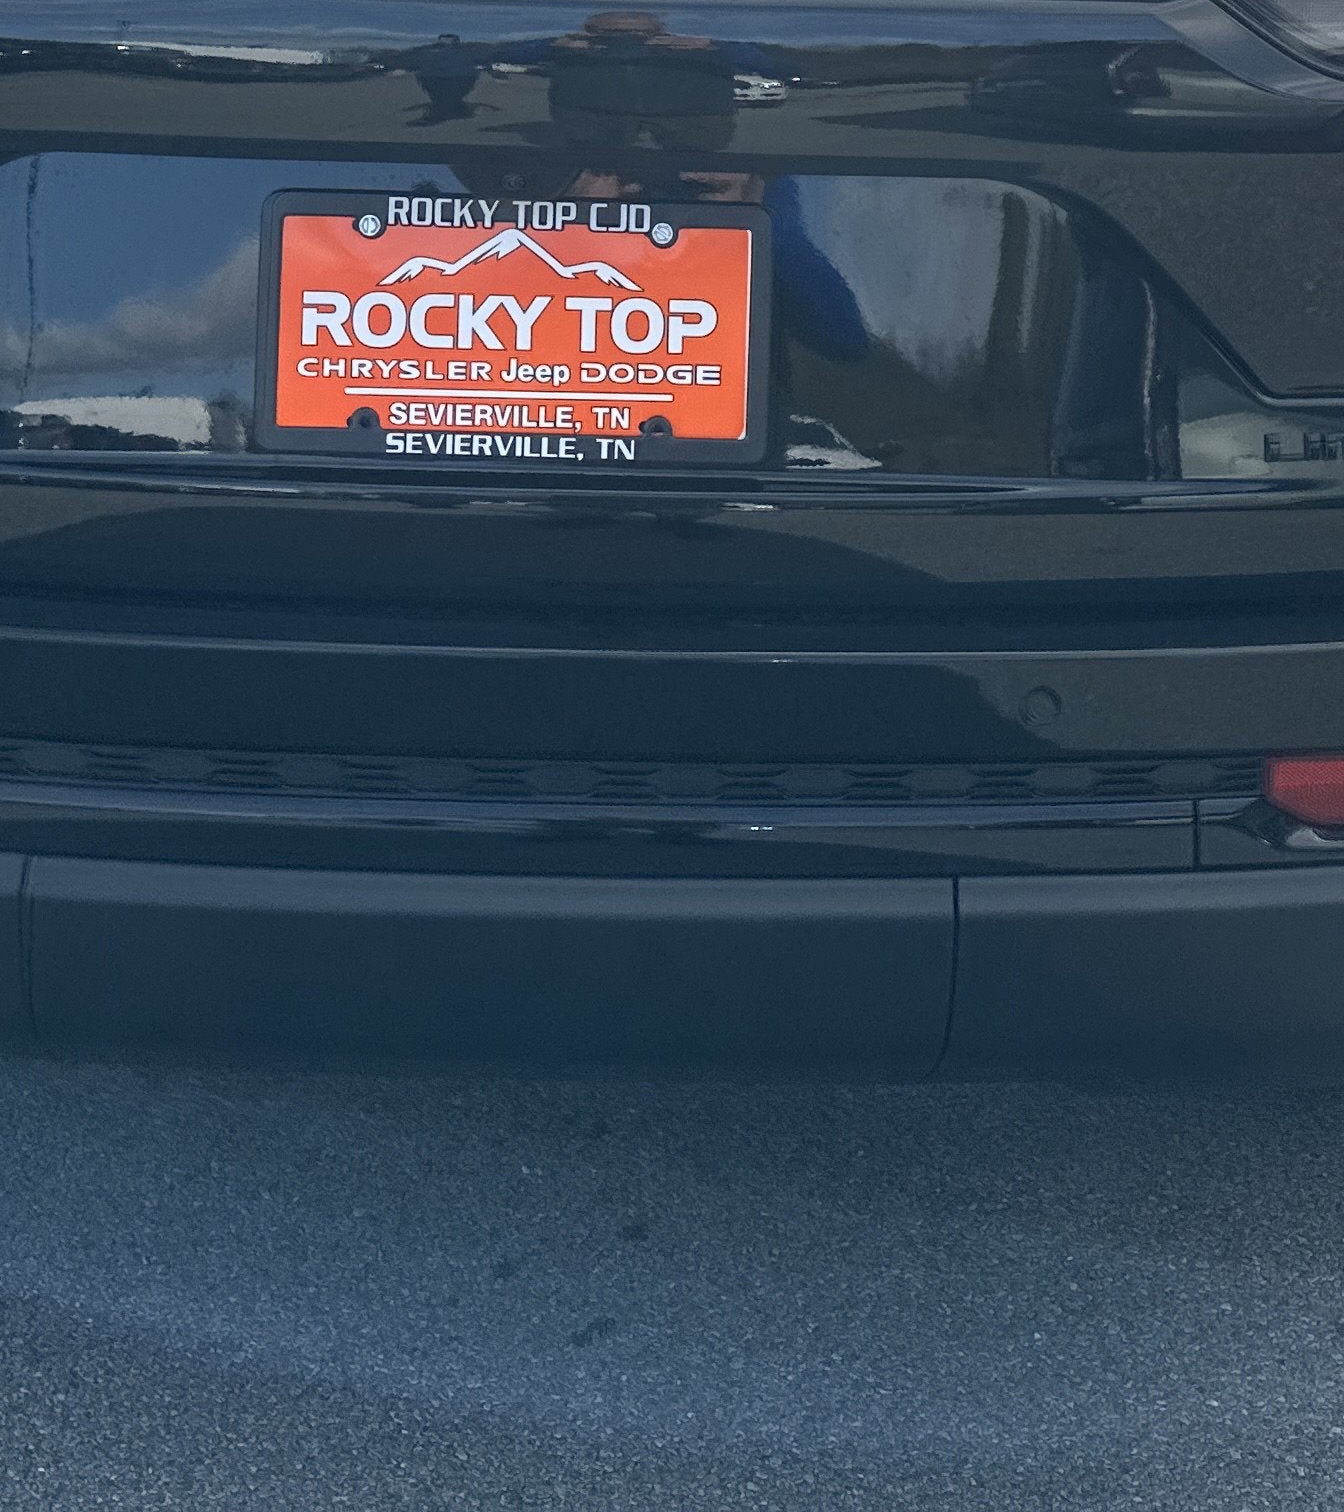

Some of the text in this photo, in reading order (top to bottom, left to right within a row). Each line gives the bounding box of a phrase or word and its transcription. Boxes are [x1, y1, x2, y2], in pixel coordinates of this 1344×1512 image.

[388, 196, 652, 233] ROCKY TOP CJD
[301, 290, 718, 354] ROCKY TOP
[296, 357, 722, 387] CHRYSLER Jeep DODGE
[388, 402, 630, 432] SEVIERVILLE, TN
[386, 433, 635, 462] SEVIERVILLE, TN
